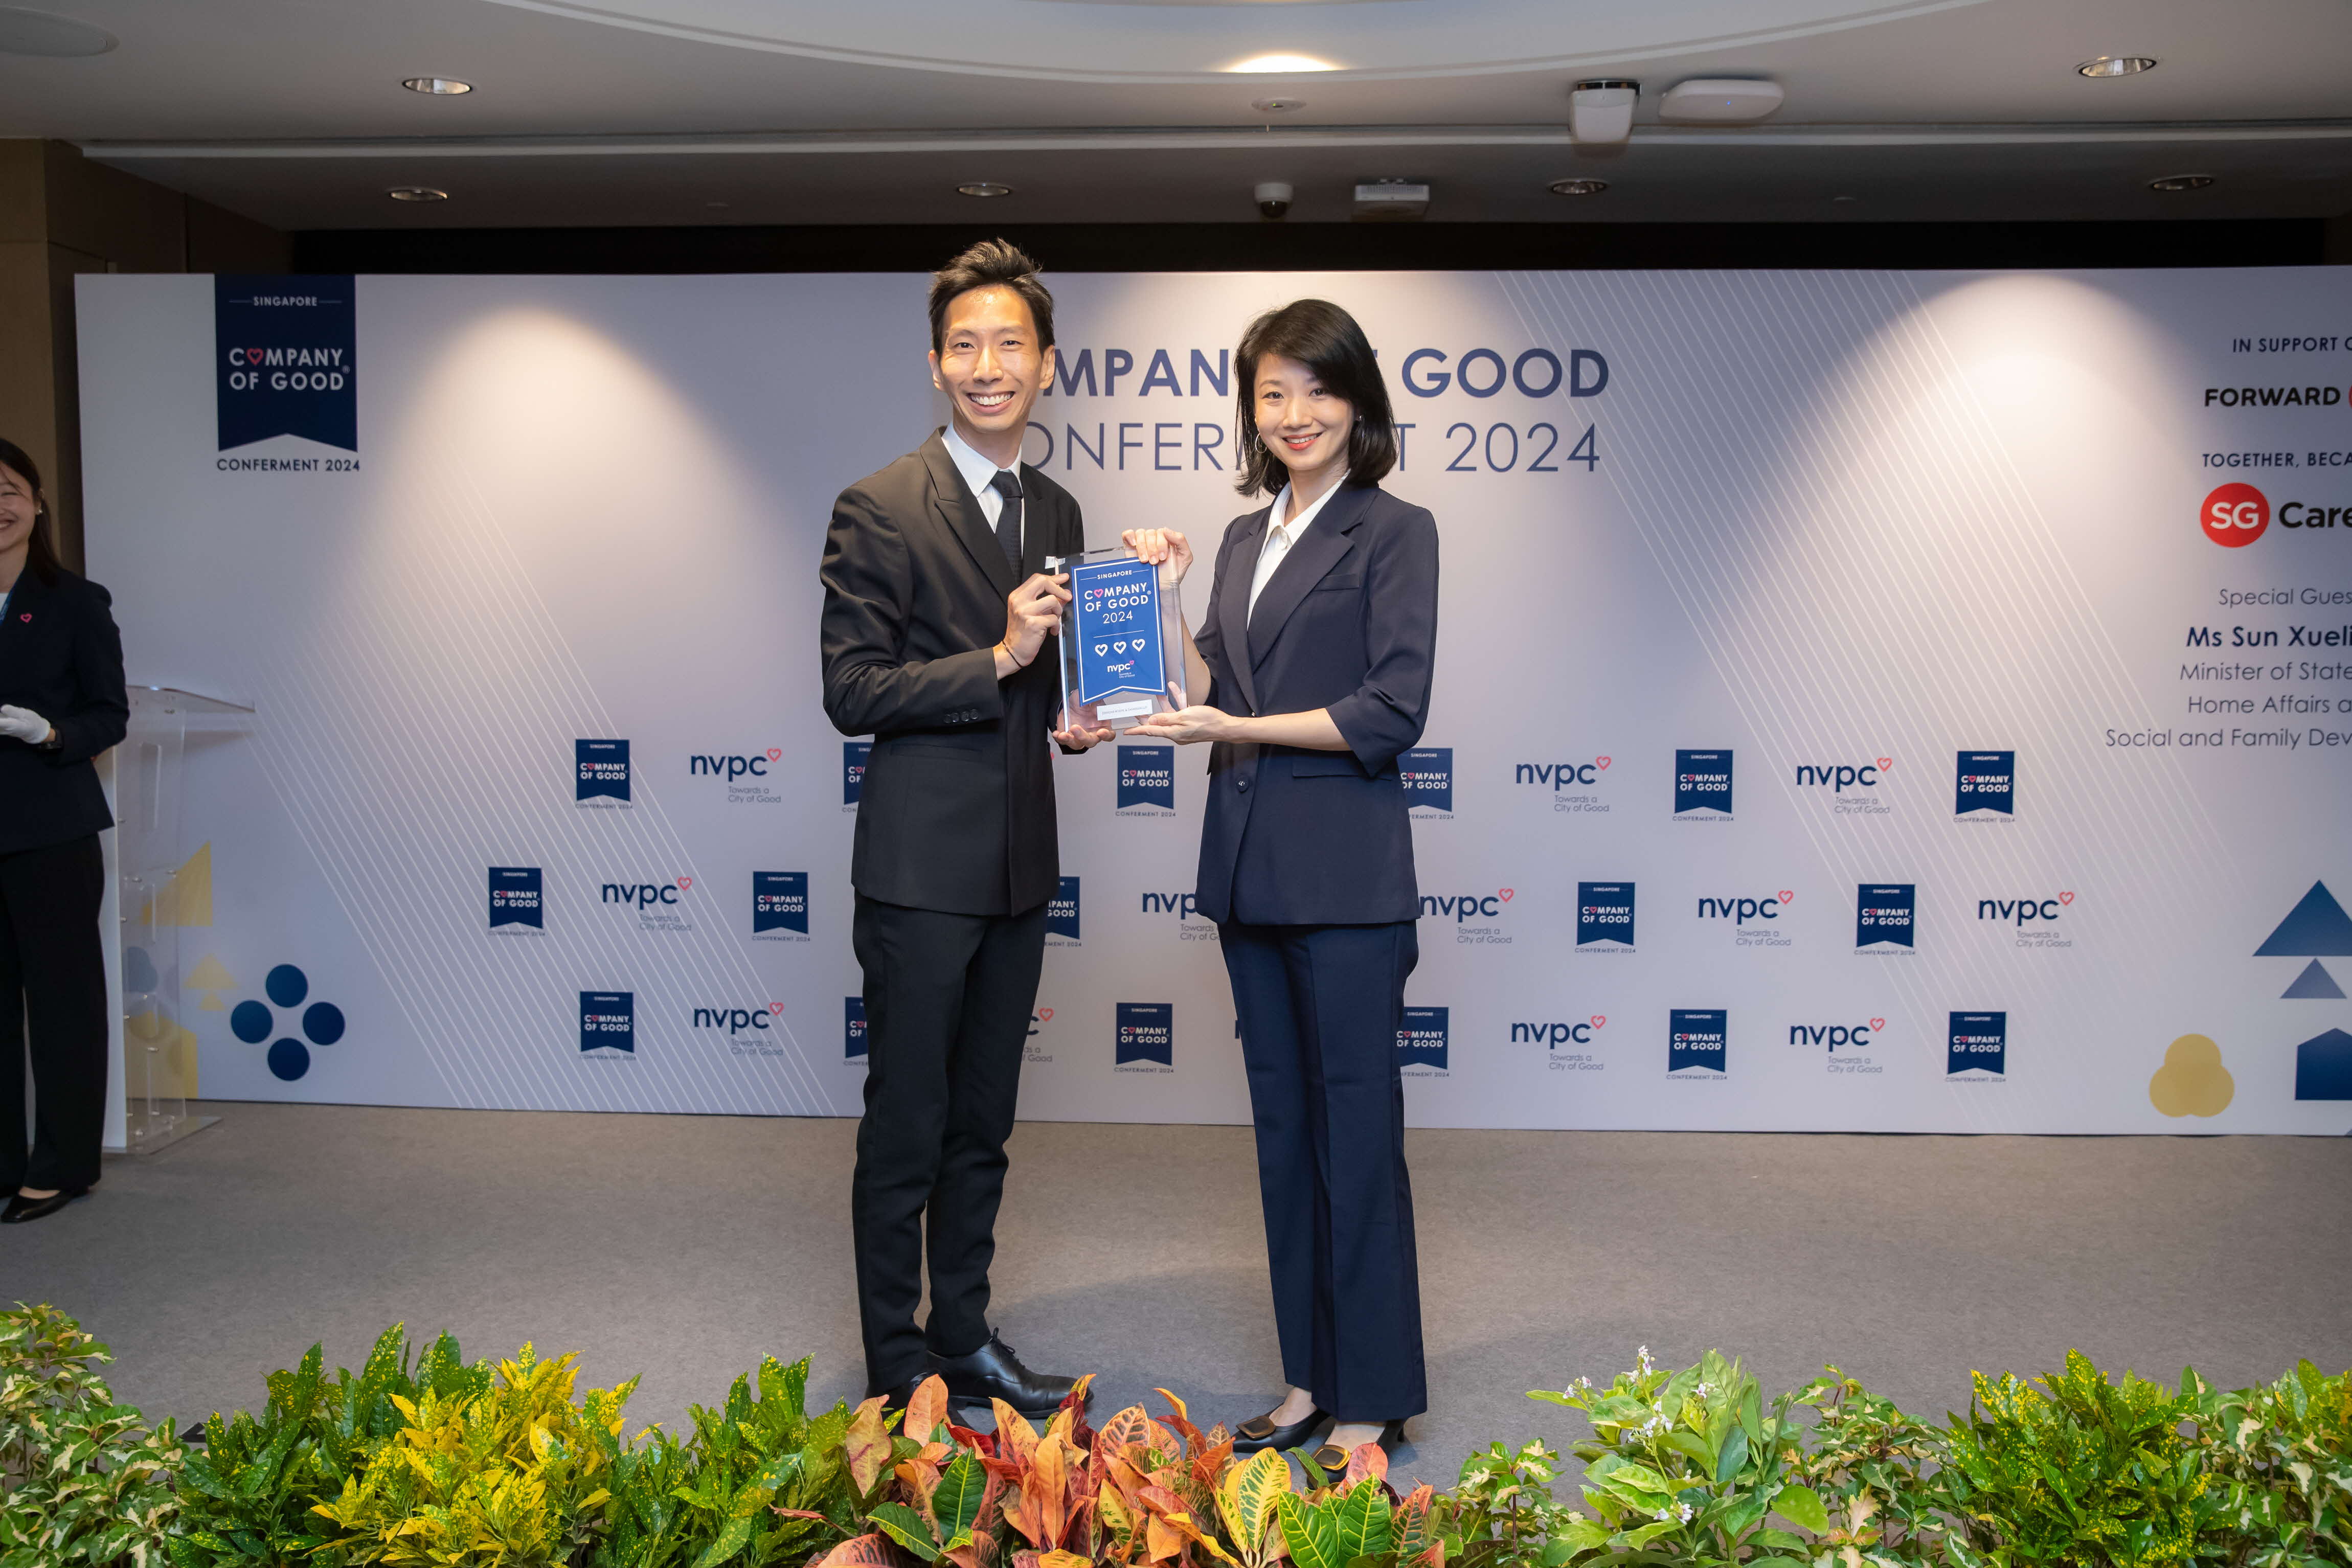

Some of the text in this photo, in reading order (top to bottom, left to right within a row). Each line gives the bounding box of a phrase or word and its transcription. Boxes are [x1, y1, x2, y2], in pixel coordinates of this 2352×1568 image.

[254, 296, 318, 306] SINGAPORE
[2233, 338, 2251, 353] IN
[2258, 337, 2338, 352] SUPPORT
[230, 371, 259, 390] OF
[1043, 348, 1609, 398] MPAN GOOD
[2204, 387, 2341, 407] FORWARD
[1445, 422, 1600, 472] 2024
[217, 459, 360, 471] CONFERMENT 2024
[2203, 453, 2300, 468] TOGETHER,
[2210, 501, 2259, 530] SG
[1097, 570, 1132, 579] SINGAPORE
[1085, 601, 1101, 612] OF
[2219, 588, 2294, 608] Special
[1102, 610, 1133, 624] 2024
[2186, 626, 2222, 647] Ms
[2231, 626, 2278, 647] Sun
[1107, 663, 1131, 673] nvpc
[2180, 663, 2264, 680] Minister
[2270, 662, 2293, 680] of
[2188, 696, 2254, 713] Home
[2261, 695, 2330, 713] Affairs
[2106, 729, 2171, 747] Social
[2179, 729, 2223, 746] and
[2231, 729, 2301, 749] Family
[691, 755, 767, 782] nvpc
[1516, 764, 1596, 791] nvpc
[1797, 765, 1876, 792] nvpc
[602, 883, 677, 910] nvpc
[1143, 893, 1196, 920] nvp
[1420, 896, 1499, 923] nvpc
[1699, 898, 1778, 924] nvpc
[1979, 899, 2058, 926] nvpc
[1180, 933, 1196, 941] City
[1457, 936, 1473, 944] City
[694, 1008, 770, 1034] nvpc
[1511, 1022, 1591, 1049] nvpc
[1791, 1025, 1870, 1052] nvpc
